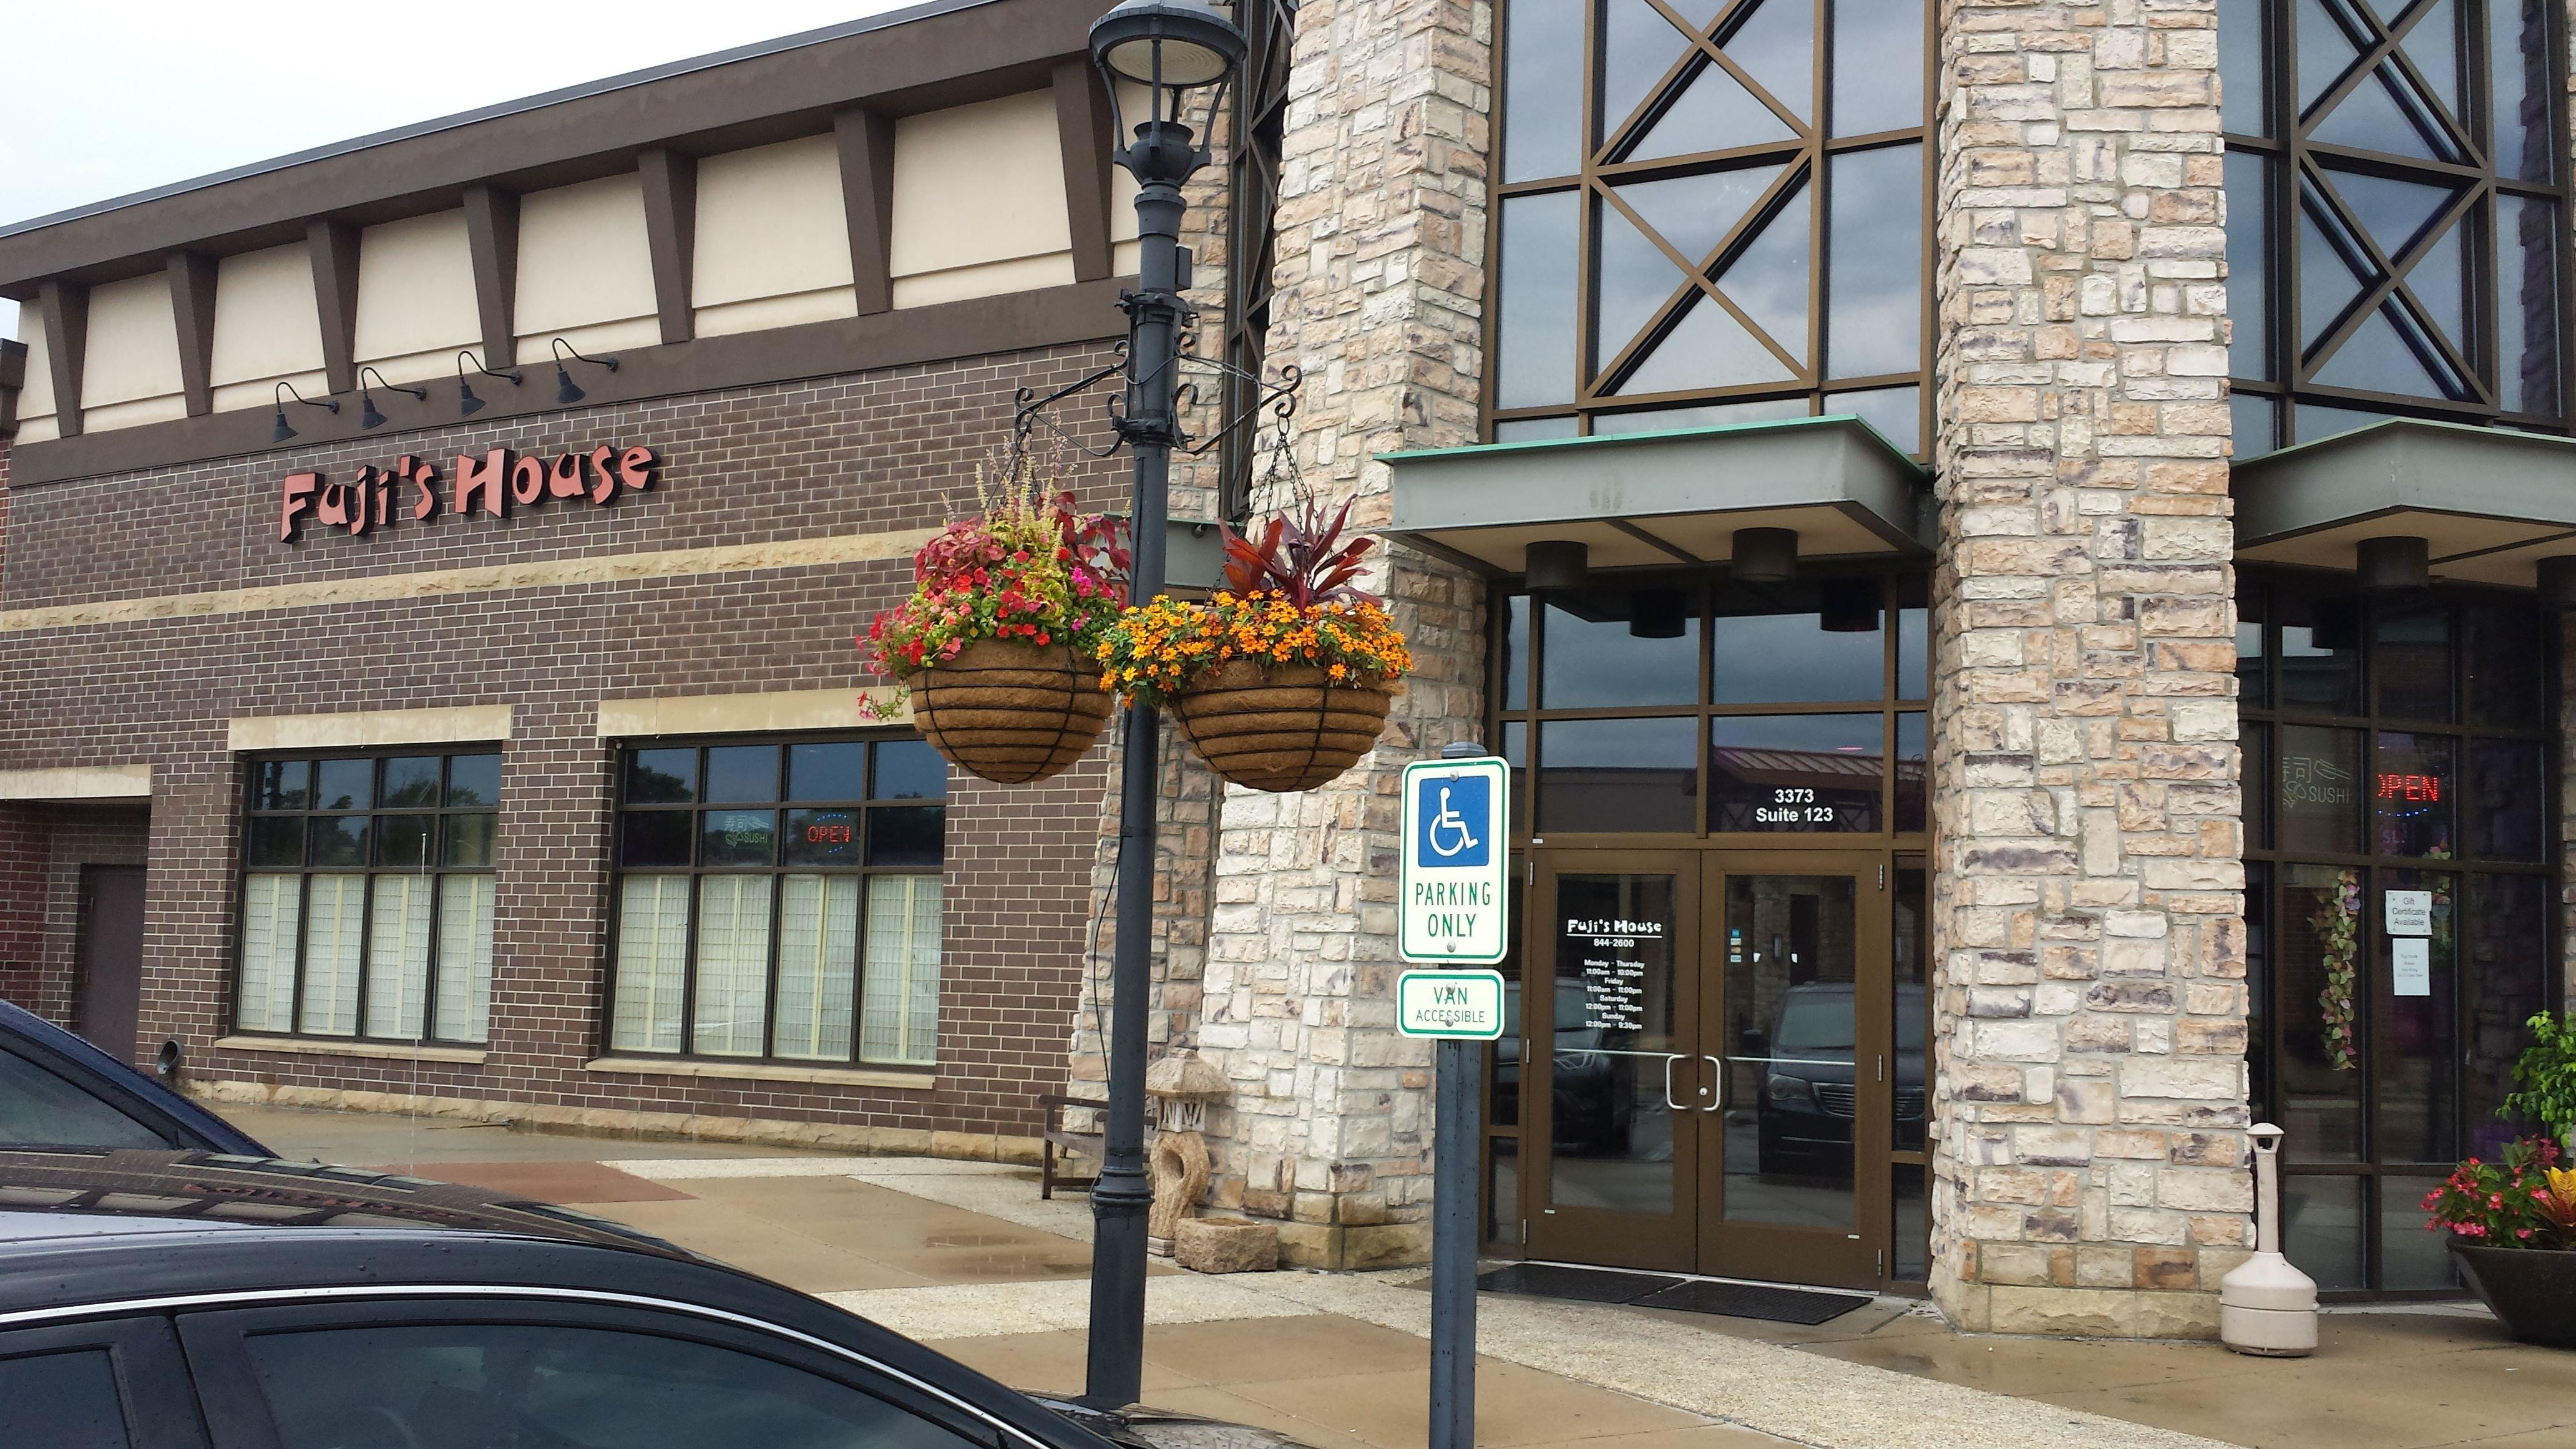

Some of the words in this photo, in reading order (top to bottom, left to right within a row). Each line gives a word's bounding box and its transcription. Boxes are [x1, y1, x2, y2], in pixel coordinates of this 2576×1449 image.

[280, 455, 442, 544] Fuji's
[454, 444, 661, 519] House
[1775, 788, 1814, 803] 3373
[2308, 786, 2349, 804] SUSHI
[1755, 807, 1799, 822] Suite
[1804, 807, 1833, 822] 123
[744, 832, 768, 844] SUSHI
[807, 825, 851, 842] OPEN
[1415, 882, 1491, 906] PARKING
[2392, 907, 2426, 915] Certificate
[1428, 914, 1476, 937] ONLY
[1568, 919, 1610, 933] Fuji's
[1614, 920, 1662, 934] House
[1593, 939, 1634, 947] 844-2600
[1584, 959, 1609, 968] Monday
[1616, 960, 1645, 969] Thursday
[1604, 977, 1624, 985] Friday
[1433, 987, 1468, 1005] VAN
[1618, 987, 1642, 995] 11:00pm
[1599, 995, 1629, 1003] Saturday
[1586, 1003, 1611, 1011] 12:00pm
[1415, 1009, 1485, 1023] ACCESSIBLE
[1601, 1012, 1626, 1021] Sunday
[1586, 1020, 1611, 1028] 12:00pm
